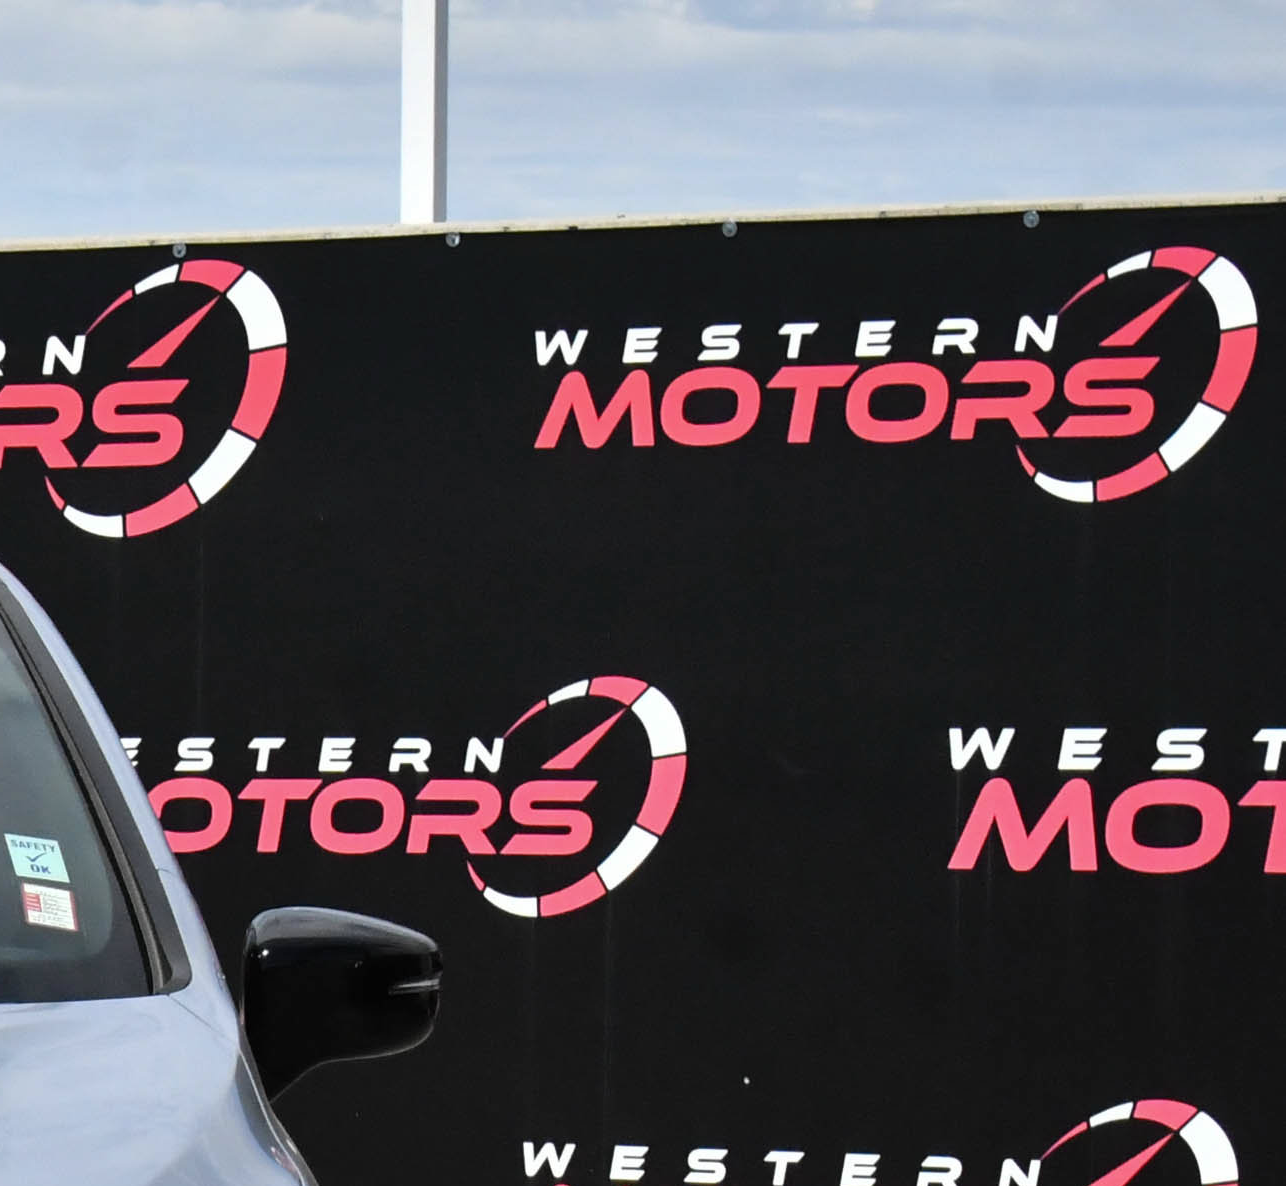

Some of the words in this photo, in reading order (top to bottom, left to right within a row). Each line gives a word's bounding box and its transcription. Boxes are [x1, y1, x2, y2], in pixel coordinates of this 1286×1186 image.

[534, 314, 1059, 365] WESTERN
[534, 359, 1161, 449] MOTORS
[10, 839, 55, 853] SAFETY
[30, 863, 51, 874] OK
